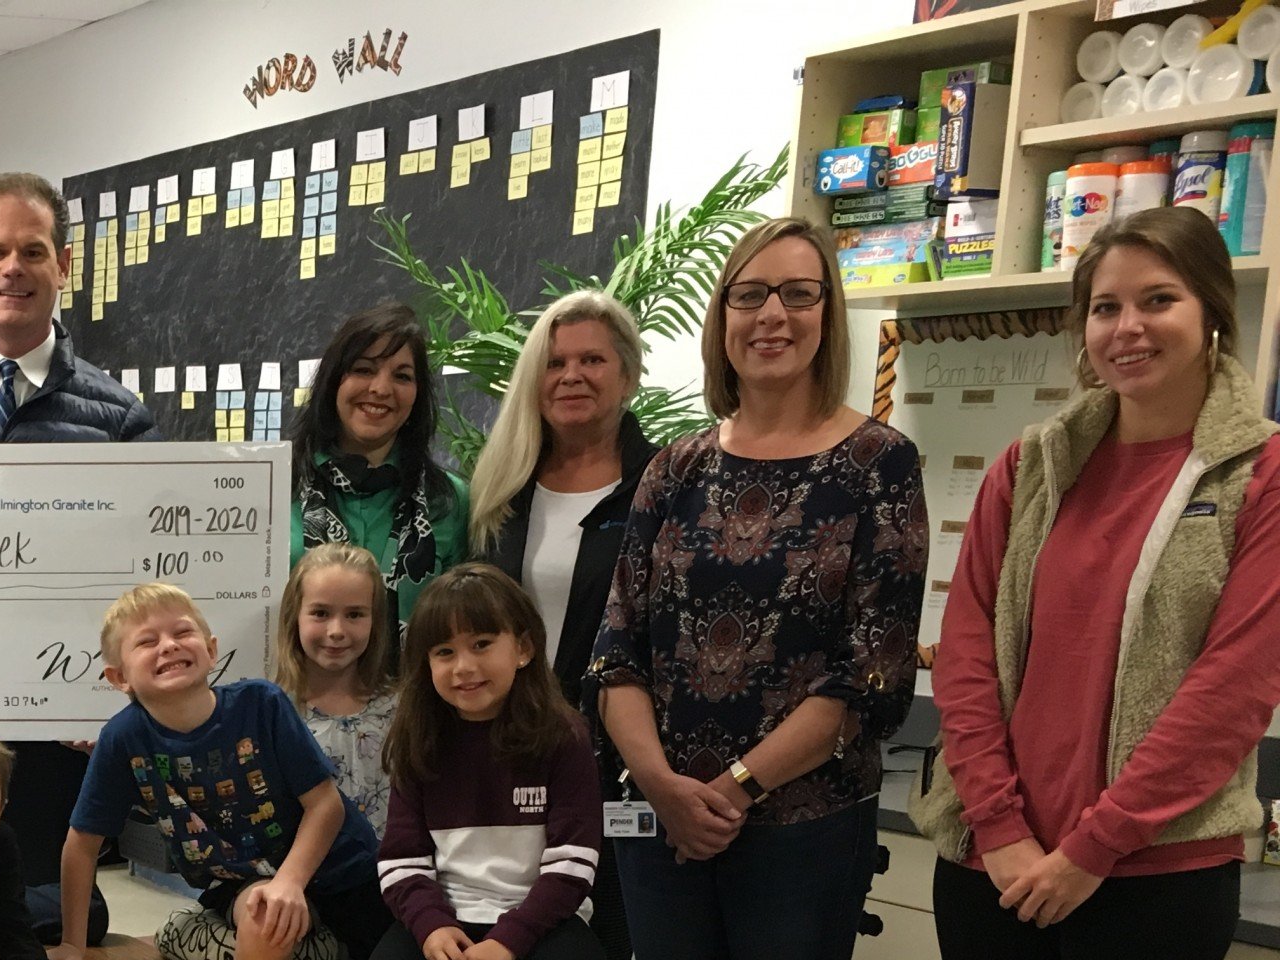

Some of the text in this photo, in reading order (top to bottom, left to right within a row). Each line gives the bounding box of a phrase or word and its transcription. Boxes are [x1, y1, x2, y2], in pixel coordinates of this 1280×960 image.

[243, 27, 408, 110] WORD WALL
[600, 79, 616, 107] M
[889, 144, 938, 171] BOGGL
[925, 349, 1050, 386] Born to be Wild
[213, 477, 245, 489] 1000
[51, 499, 95, 510] Granite
[149, 505, 258, 536] 2019-2020
[216, 591, 258, 600] DOLLARS
[513, 786, 548, 806] OUTER
